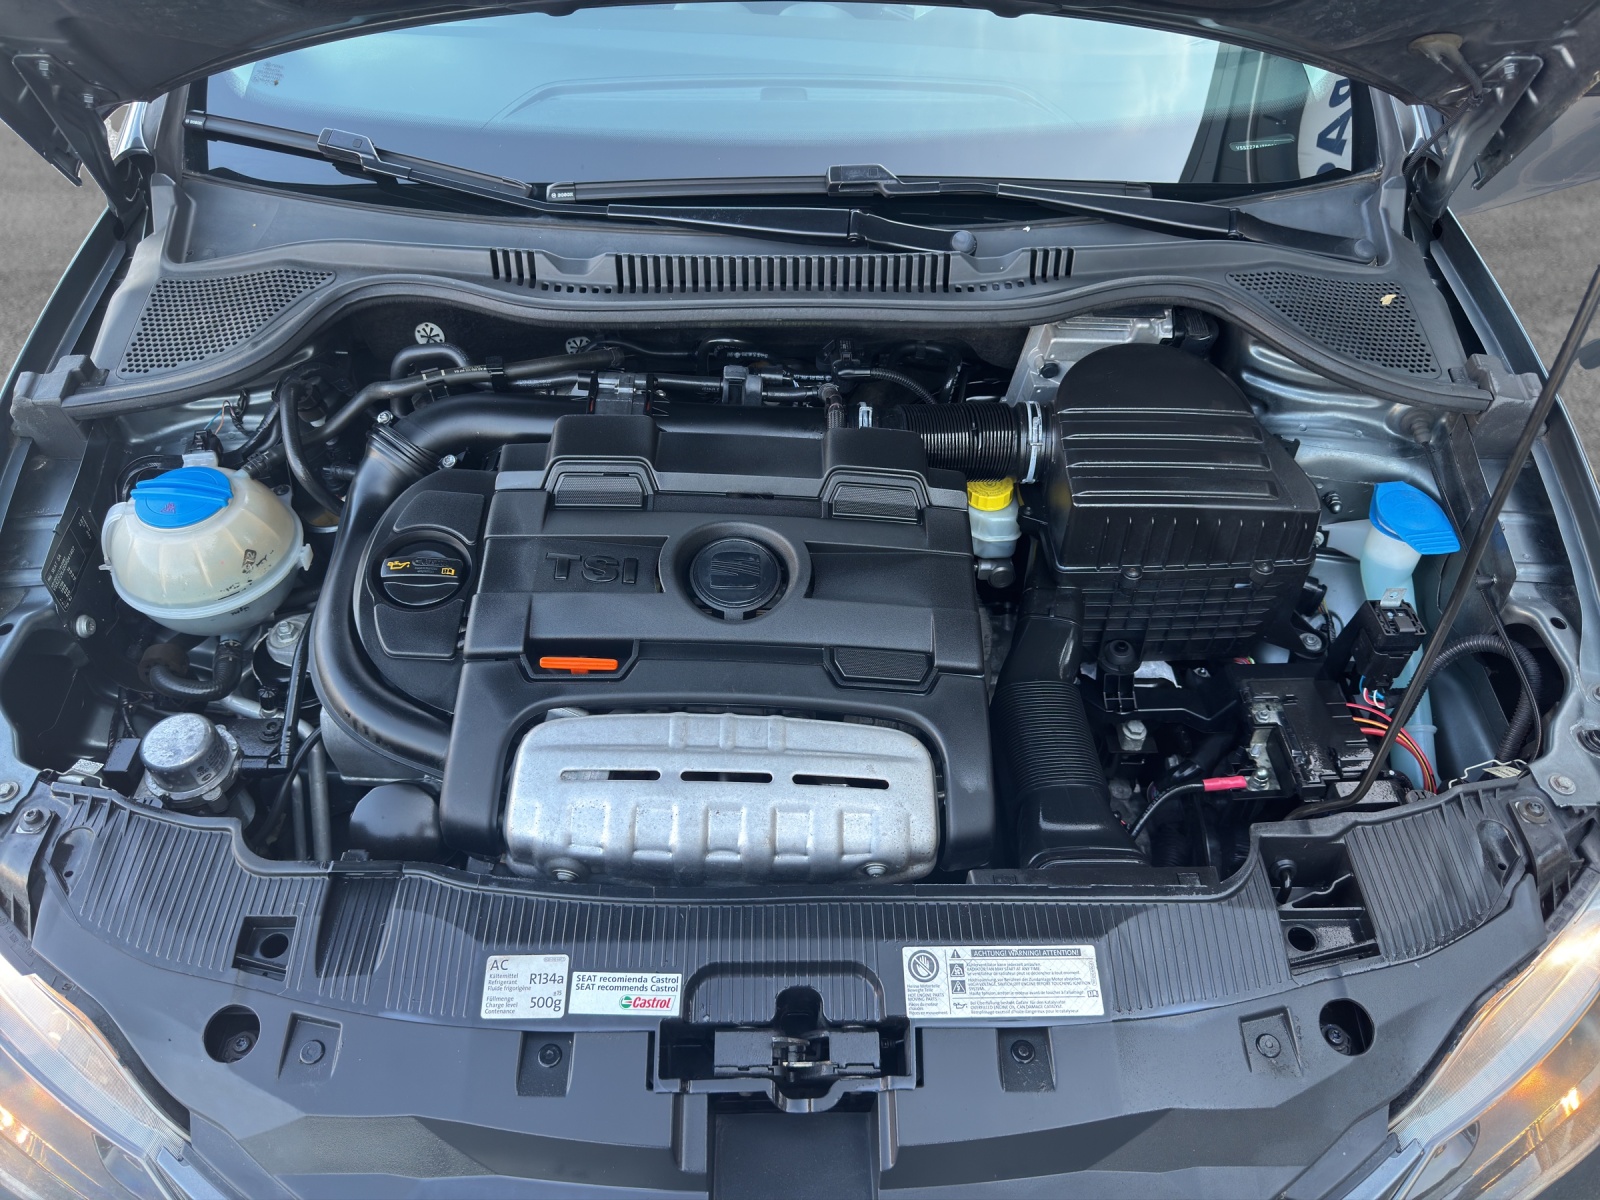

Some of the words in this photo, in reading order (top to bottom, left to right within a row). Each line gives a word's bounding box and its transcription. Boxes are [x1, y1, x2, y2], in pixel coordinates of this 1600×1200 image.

[546, 552, 639, 584] TSI
[490, 959, 509, 970] AC
[529, 973, 564, 985] R134a
[530, 996, 562, 1012] 500g
[632, 996, 671, 1008] Castrol
